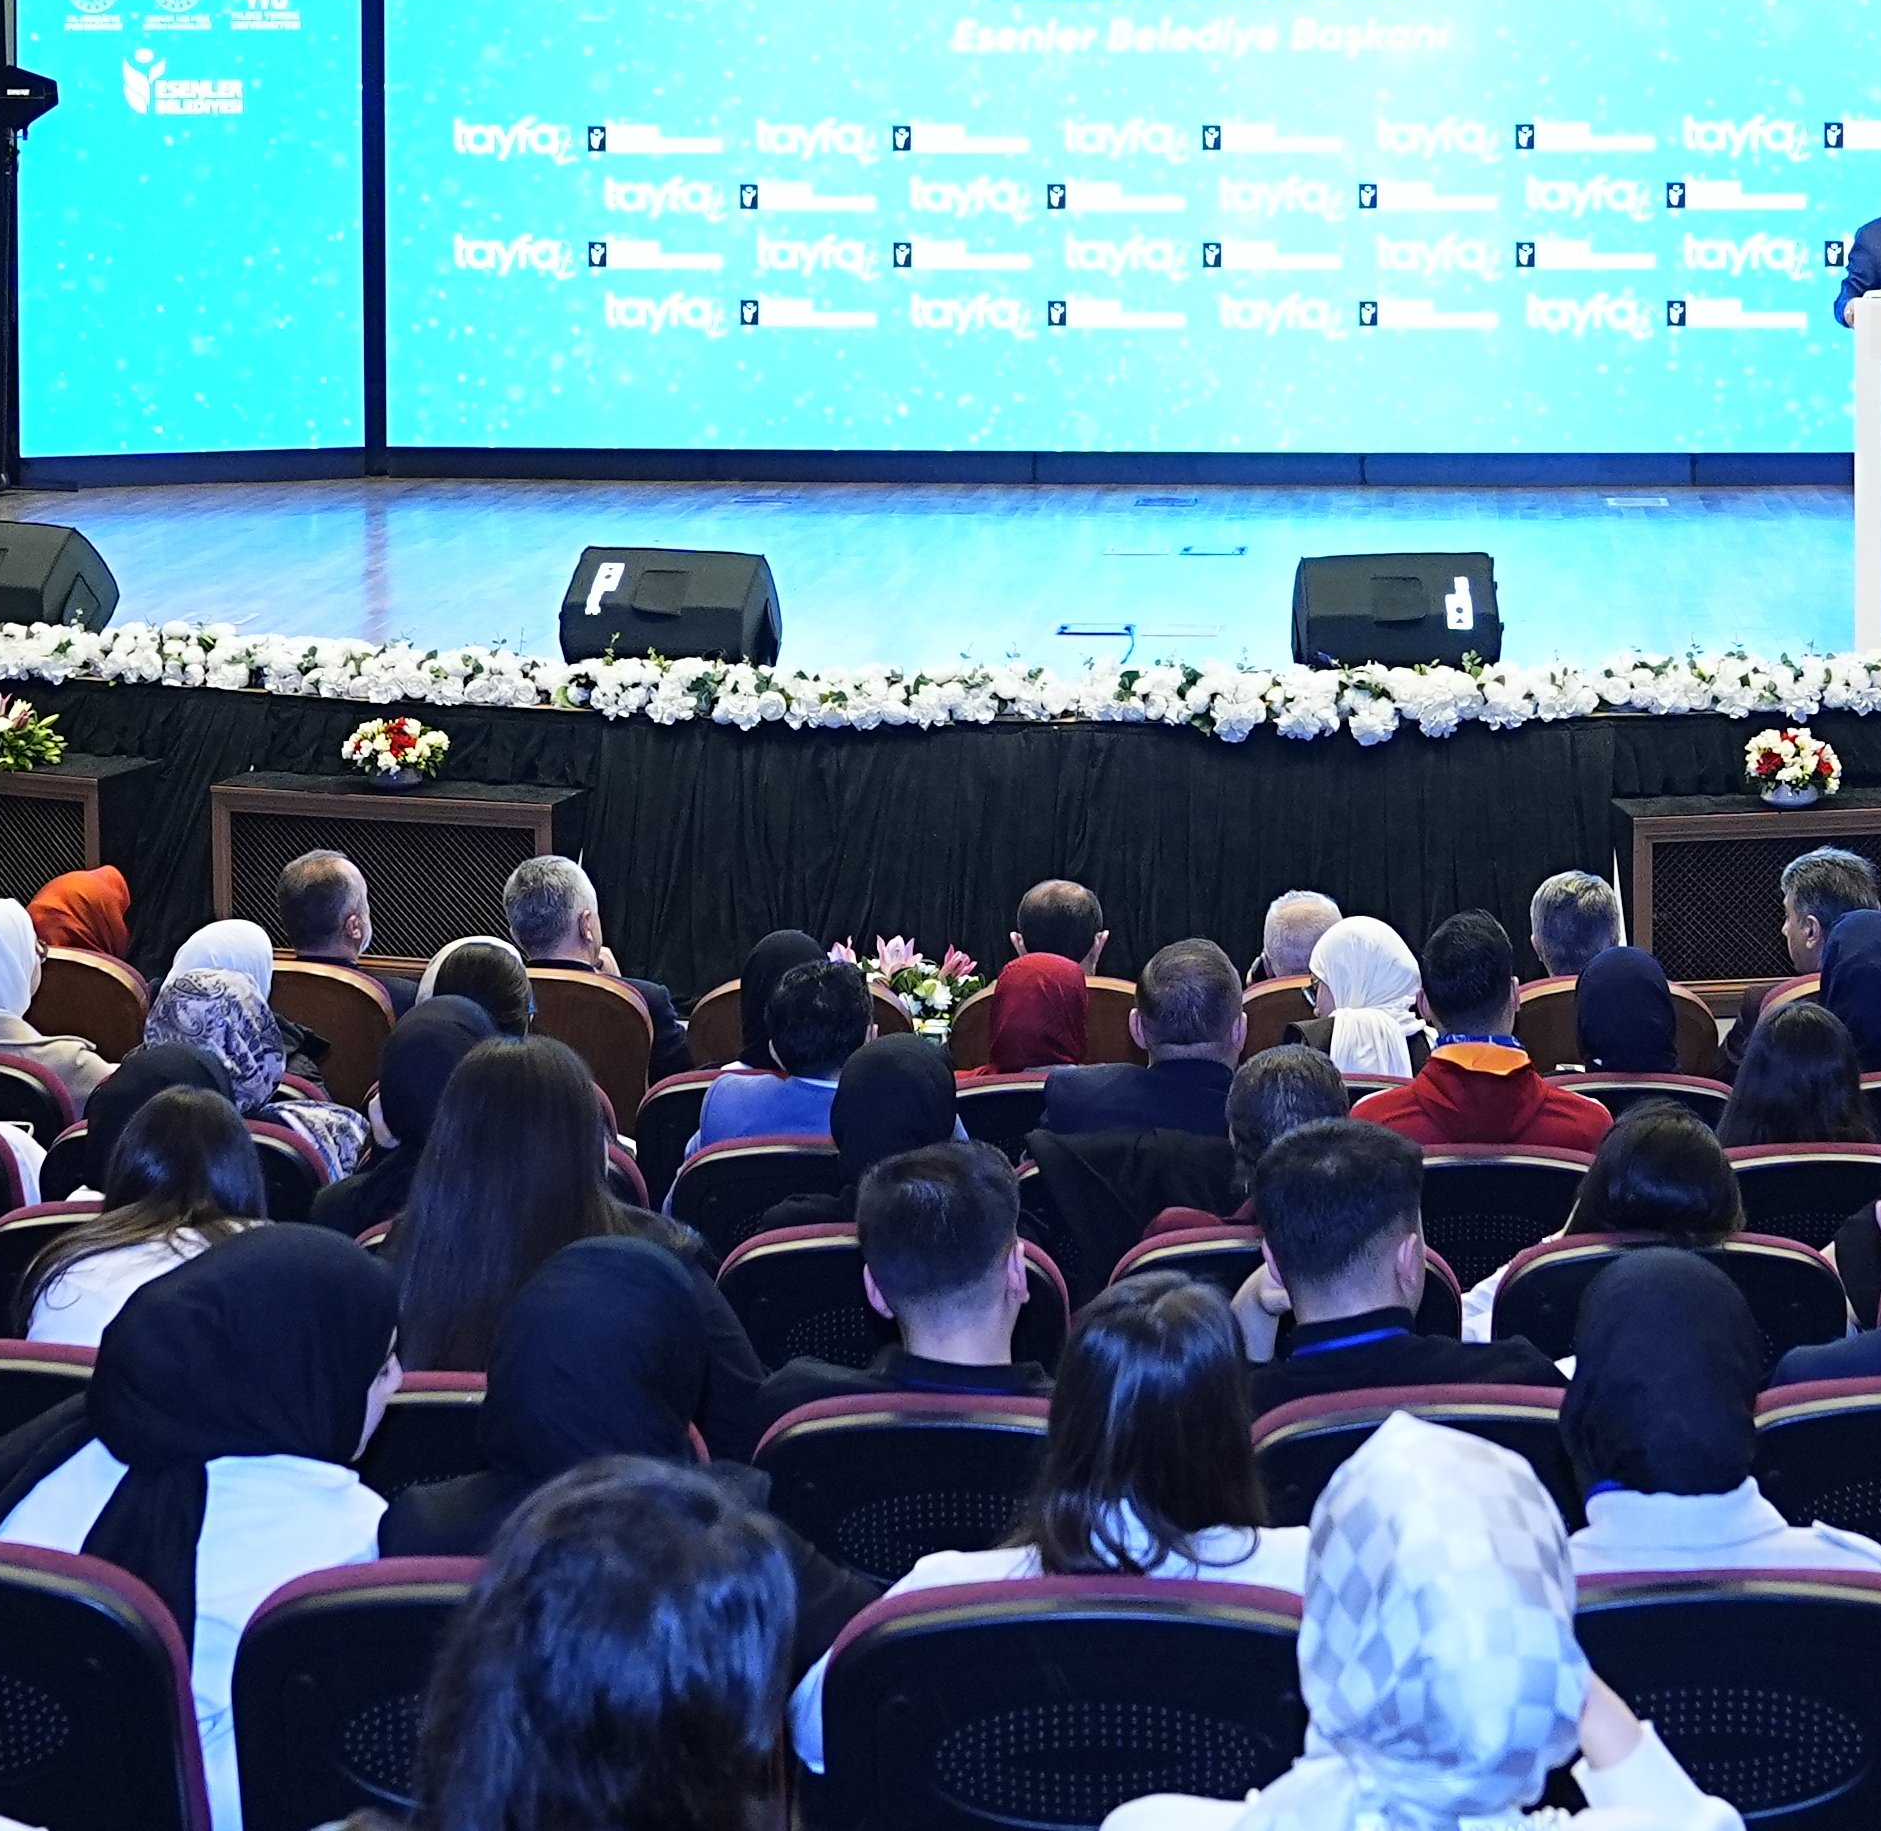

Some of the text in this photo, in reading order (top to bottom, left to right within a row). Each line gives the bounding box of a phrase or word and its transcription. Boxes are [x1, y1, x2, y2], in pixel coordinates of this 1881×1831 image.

[454, 117, 561, 161] tayfa
[756, 117, 864, 161] tayfa
[1064, 117, 1172, 161] tayfa
[1376, 117, 1484, 161] tayfa
[604, 176, 711, 219] tayfa
[910, 176, 1017, 219] tayfa
[1220, 176, 1327, 219] tayfa
[1525, 176, 1633, 219] tayfa
[454, 234, 561, 278] tayfa
[756, 234, 864, 278] tayfa
[1065, 234, 1172, 278] tayfa
[1376, 234, 1484, 278] tayfa
[606, 293, 711, 336] tayfa
[910, 293, 1017, 336] tayfa
[1220, 293, 1327, 336] tayfa
[1526, 293, 1633, 336] tayfa
